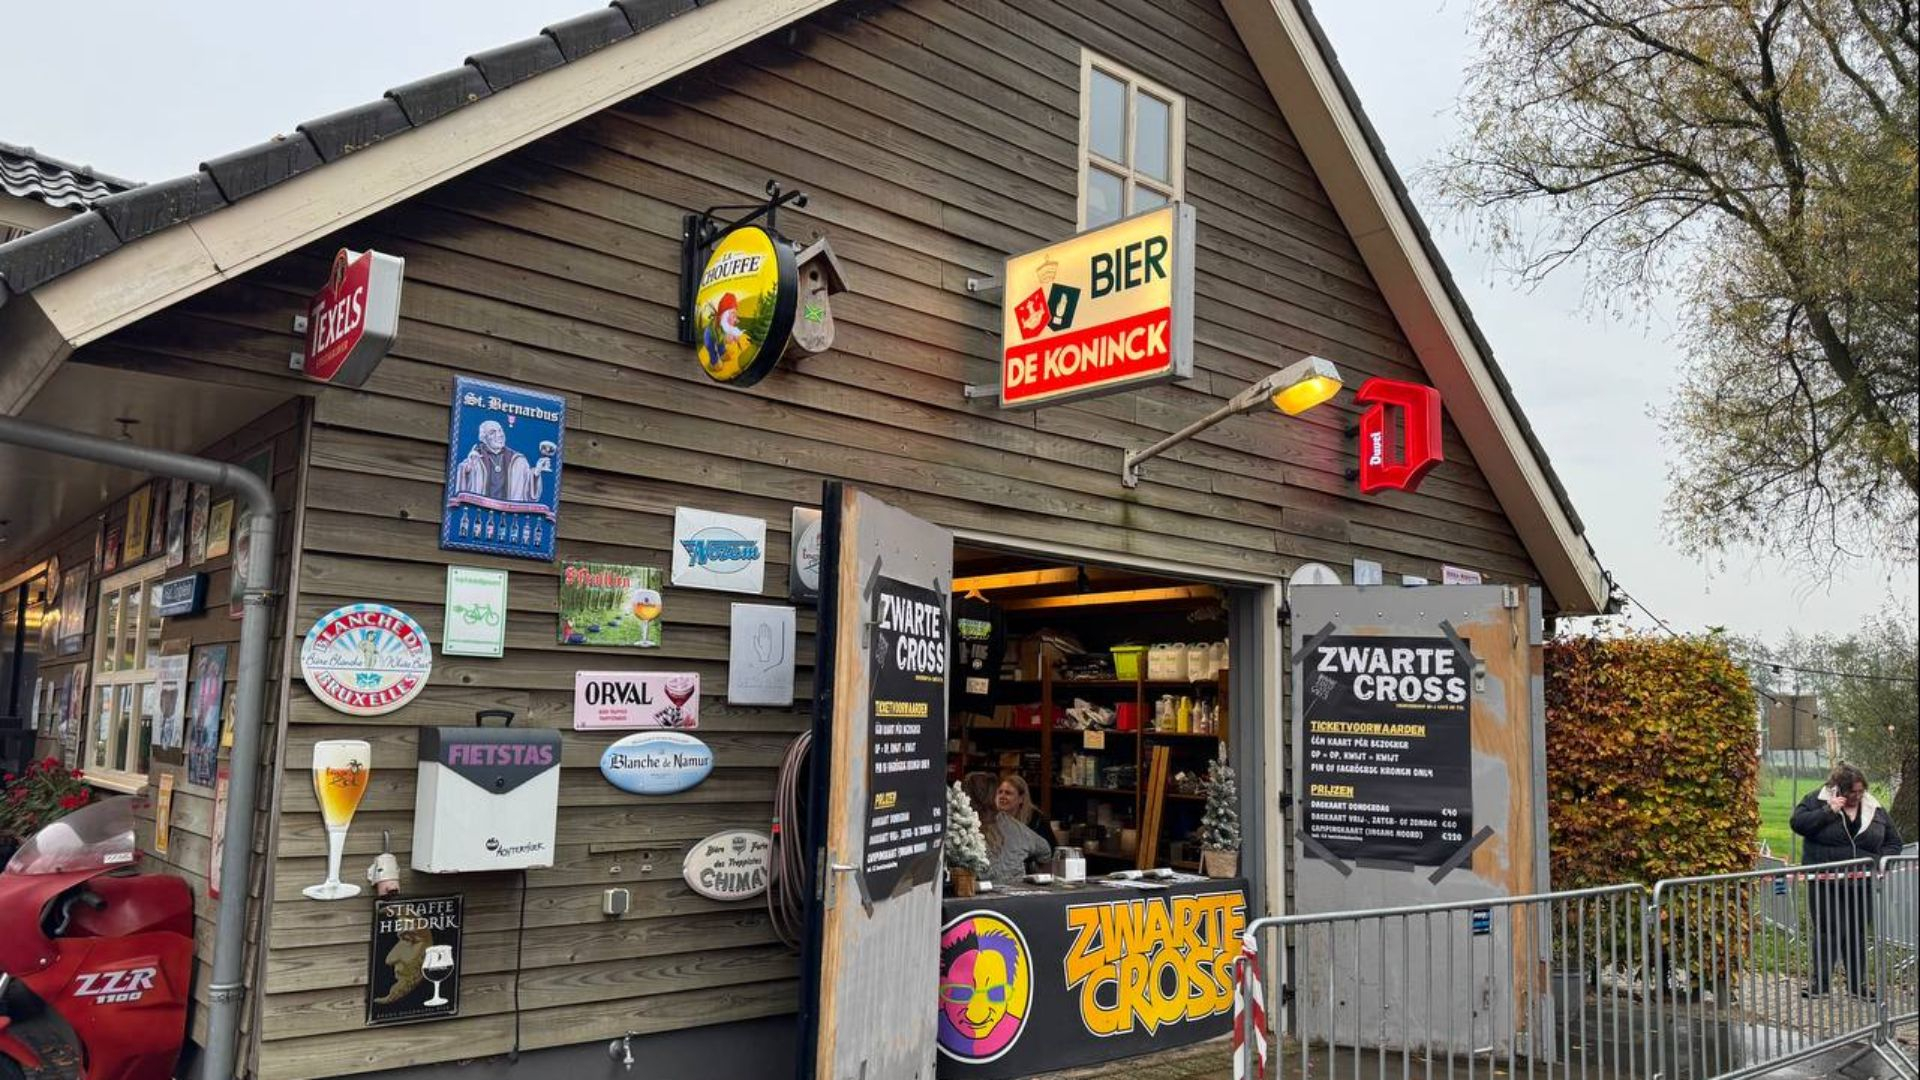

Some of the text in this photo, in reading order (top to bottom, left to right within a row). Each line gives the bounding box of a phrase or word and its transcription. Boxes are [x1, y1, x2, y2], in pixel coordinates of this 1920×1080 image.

[701, 255, 761, 287] CHOUFFE
[1091, 235, 1168, 299] BIER
[312, 286, 363, 357] TEXELS
[1007, 320, 1168, 388] DE KONINCK
[463, 392, 559, 422] St. Bernardus
[1369, 431, 1382, 466] Duvel
[878, 592, 941, 639] ZWARTE
[315, 612, 403, 653] BLANCHE
[896, 634, 944, 674] CROSS
[1317, 646, 1455, 676] ZWARTE
[318, 670, 419, 707] BRUXELLES
[585, 681, 653, 705] ORVAL
[1353, 674, 1467, 702] CROSS
[1311, 721, 1426, 736] TICKETVOORWAARDEN
[1327, 737, 1352, 746] KAART
[1370, 740, 1409, 749] BEZOEKER
[448, 743, 553, 765] FIETSTAS
[609, 750, 709, 770] Blanche de Namur
[1343, 752, 1367, 760] KWIJT
[1375, 753, 1400, 762] KWIJT
[1311, 763, 1324, 772] PIN
[1380, 766, 1411, 776] KRONEN
[1413, 768, 1433, 778] ONLY
[1311, 784, 1354, 797] PRIJZEN
[380, 901, 454, 917] STRAFFE
[1063, 890, 1248, 991] ZWARTE
[96, 991, 142, 1005] 1100
[1080, 947, 1236, 1037] CROSS
